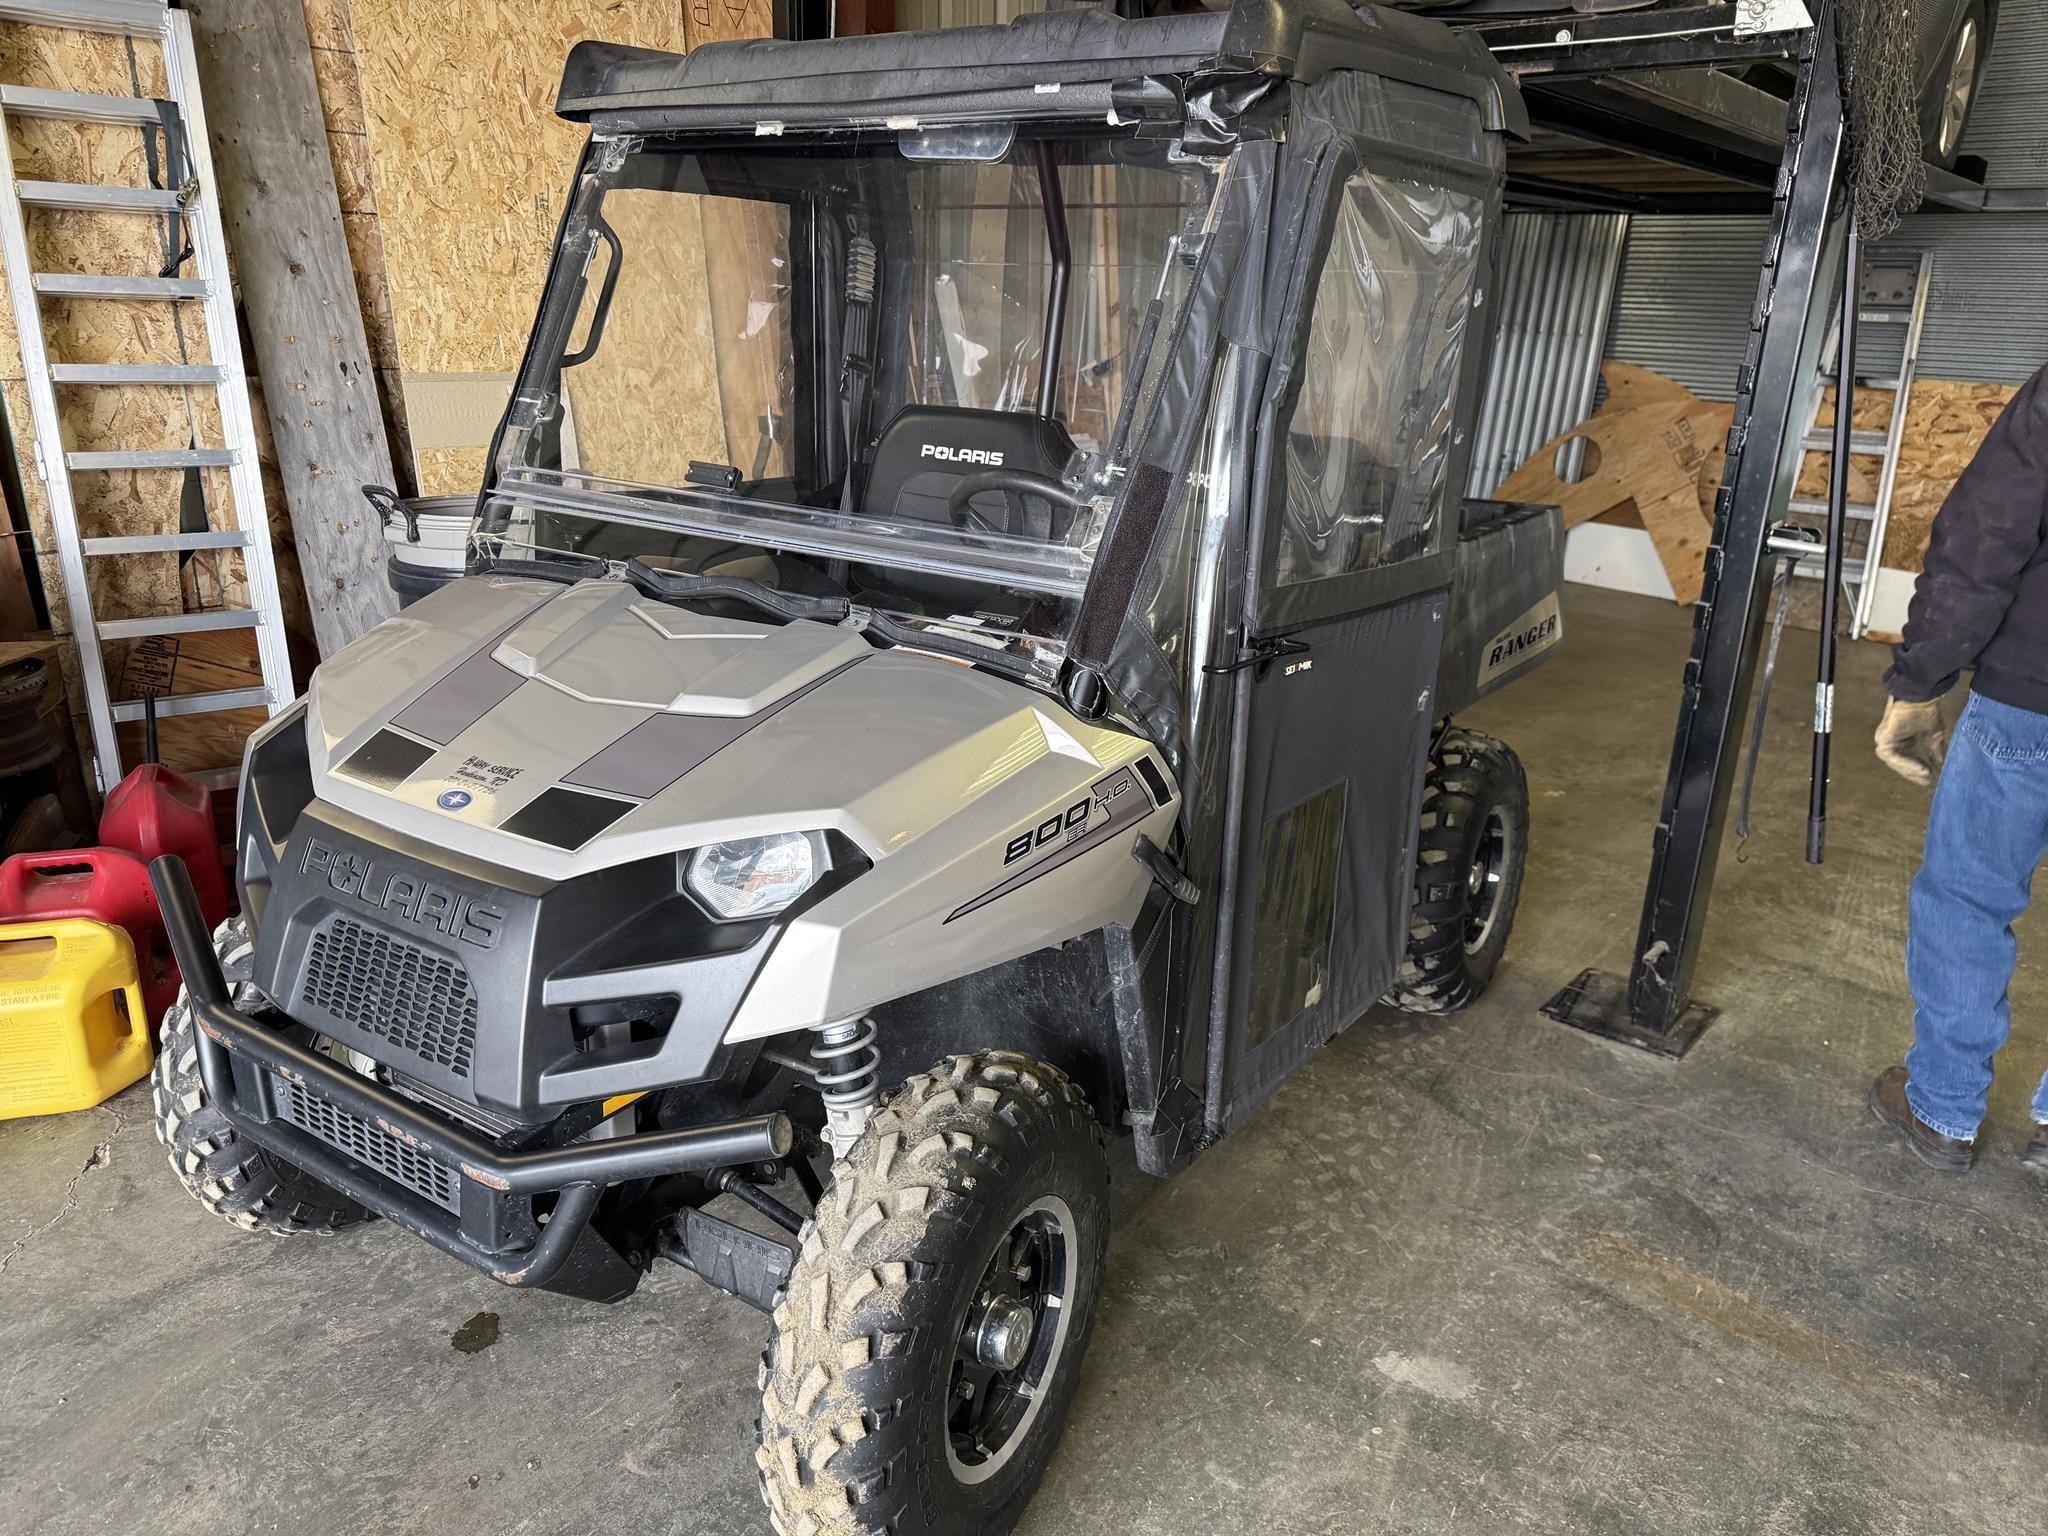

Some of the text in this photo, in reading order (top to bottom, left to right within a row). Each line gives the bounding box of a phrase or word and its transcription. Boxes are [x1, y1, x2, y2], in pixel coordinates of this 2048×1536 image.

[921, 444, 1004, 466] POLARIS
[1488, 614, 1556, 667] RANGER
[1003, 779, 1131, 866] 800 H.O.
[298, 836, 504, 949] POLARIS
[1, 995, 30, 1006] START
[31, 994, 39, 1002] A
